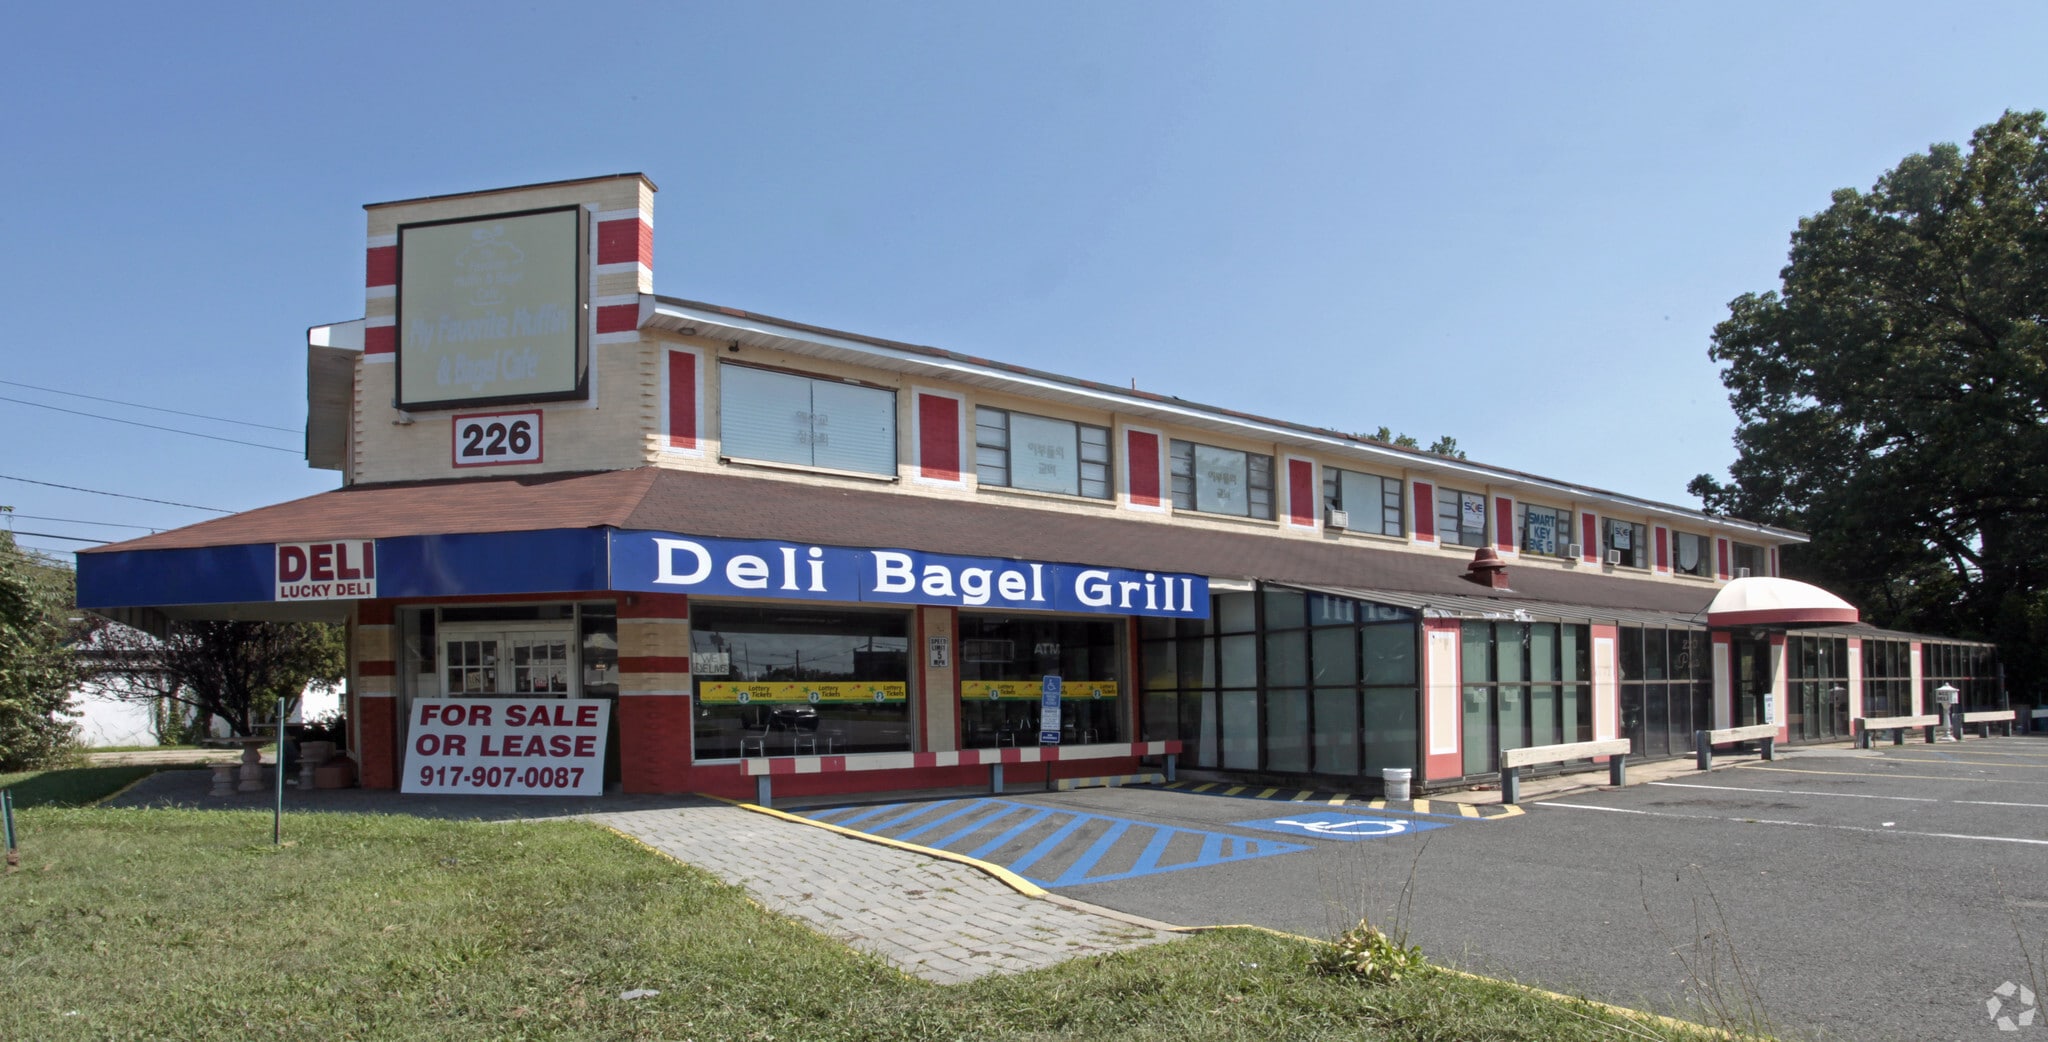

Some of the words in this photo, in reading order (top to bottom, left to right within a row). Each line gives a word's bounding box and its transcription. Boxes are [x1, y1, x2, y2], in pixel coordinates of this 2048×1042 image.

[437, 310, 509, 344] Favorite
[462, 420, 531, 456] 226
[1528, 512, 1555, 527] SMART
[1534, 526, 1551, 539] KEY
[279, 542, 374, 582] DELI
[651, 538, 828, 592] Deli
[871, 550, 1046, 605] Bagel
[1074, 570, 1194, 612] Grill
[281, 584, 331, 598] LUCKY
[336, 582, 371, 596] DELI
[937, 651, 942, 659] 5
[1034, 643, 1061, 655] ATM
[702, 654, 718, 663] WE
[748, 685, 770, 693] Lottery
[818, 685, 839, 693] Lottery
[420, 704, 492, 726] FOR
[505, 705, 599, 727] SALE
[415, 733, 467, 756] OR
[480, 734, 597, 757] LEASE
[420, 765, 584, 788] 917-907-0087
